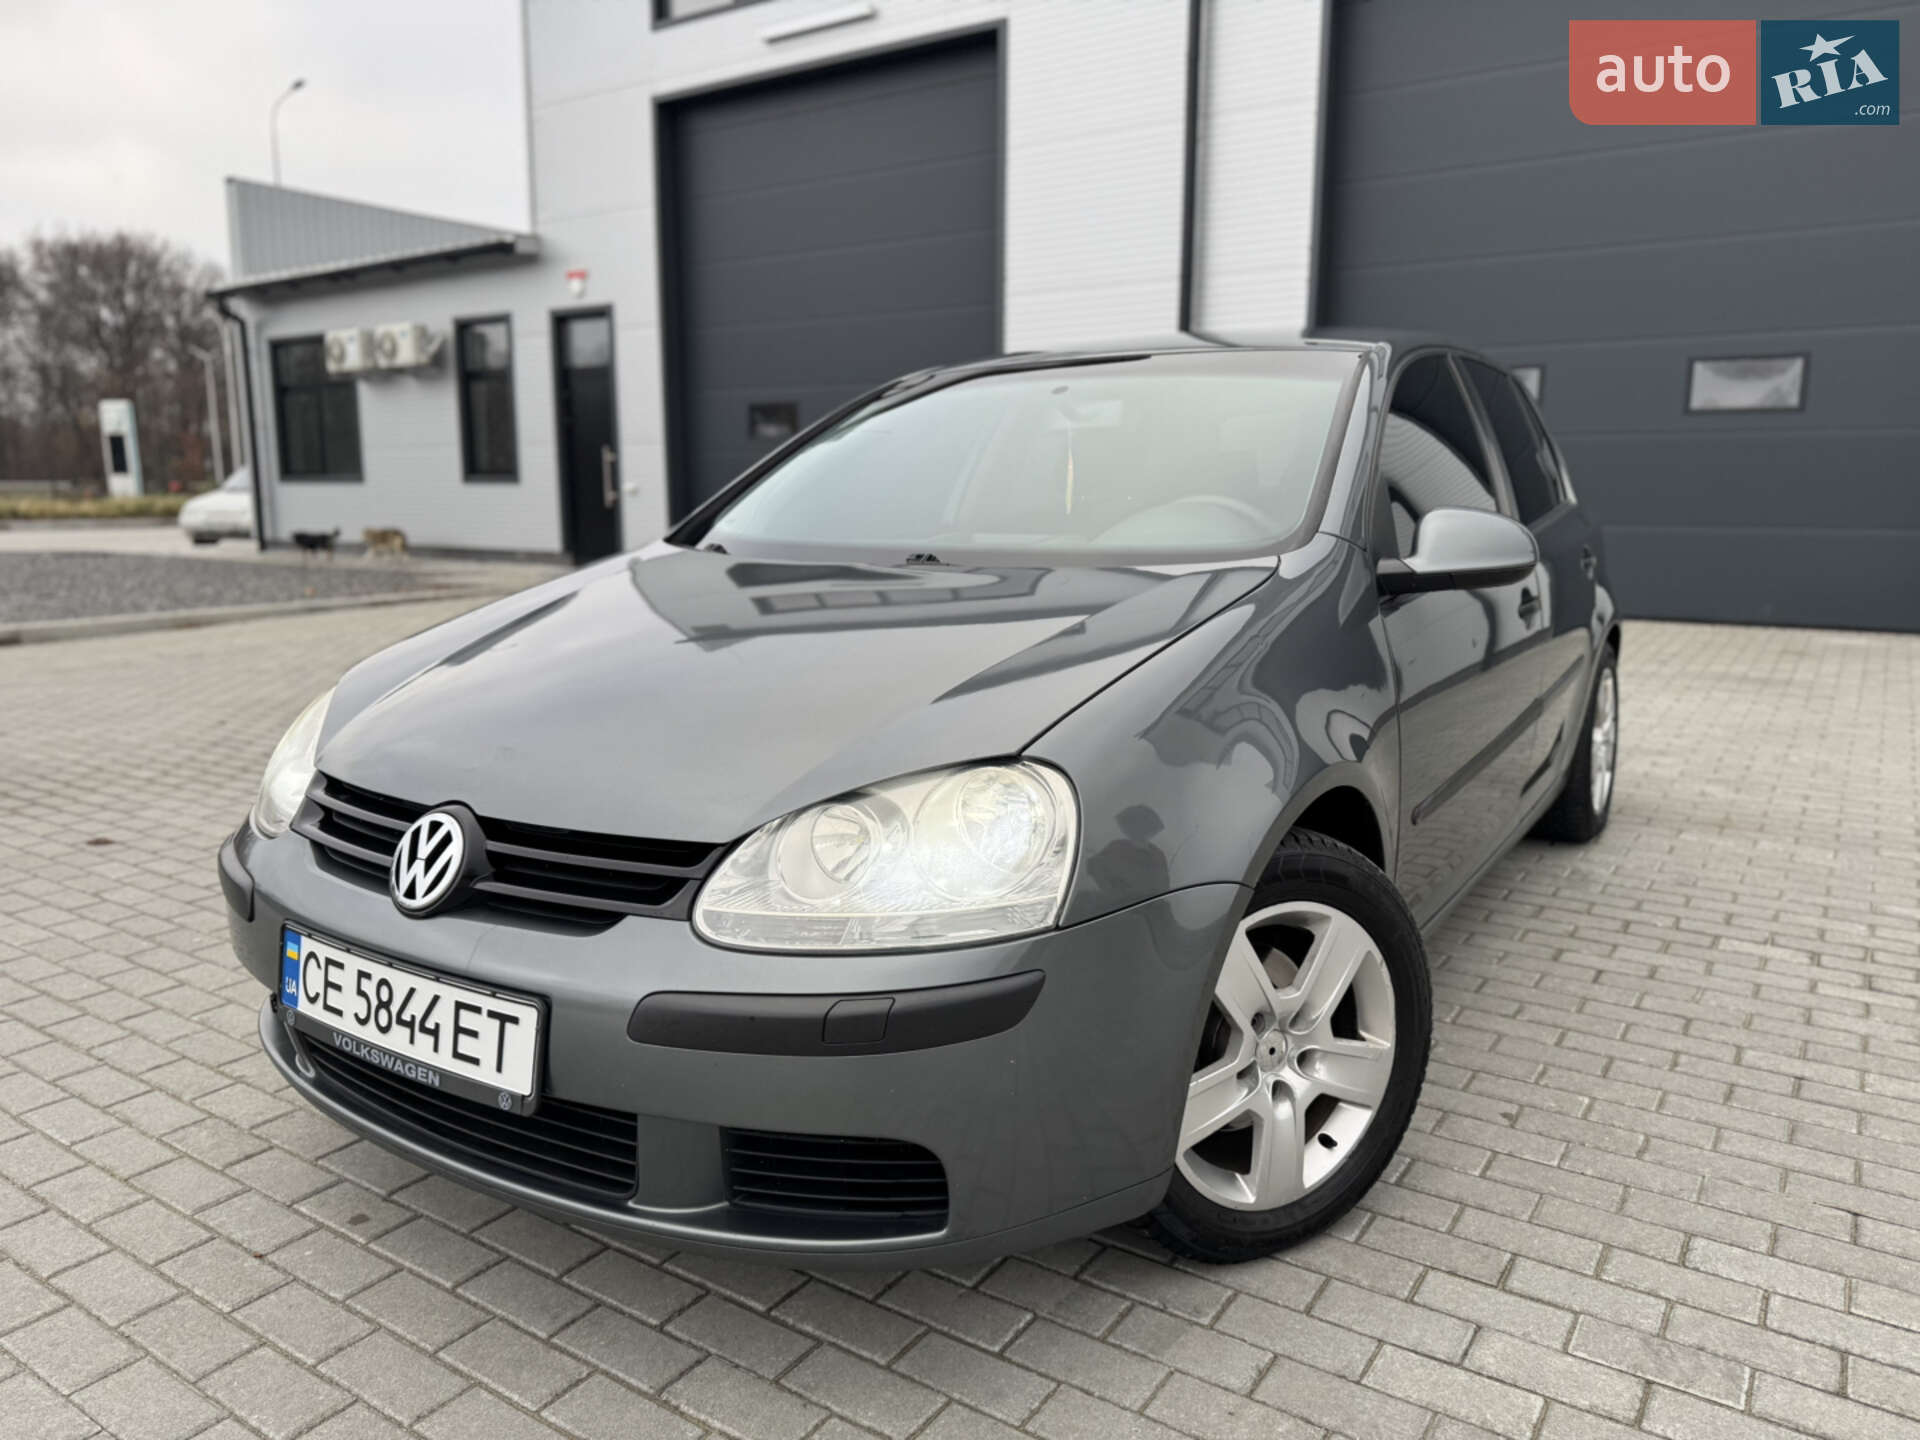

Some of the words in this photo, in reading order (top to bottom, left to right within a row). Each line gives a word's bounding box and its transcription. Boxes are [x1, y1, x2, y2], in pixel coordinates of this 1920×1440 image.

[285, 976, 297, 997] UA
[302, 951, 345, 1018] CE
[353, 969, 441, 1054] 5844
[451, 1000, 520, 1074] ET
[332, 1032, 440, 1087] VOLKSWAGEN
